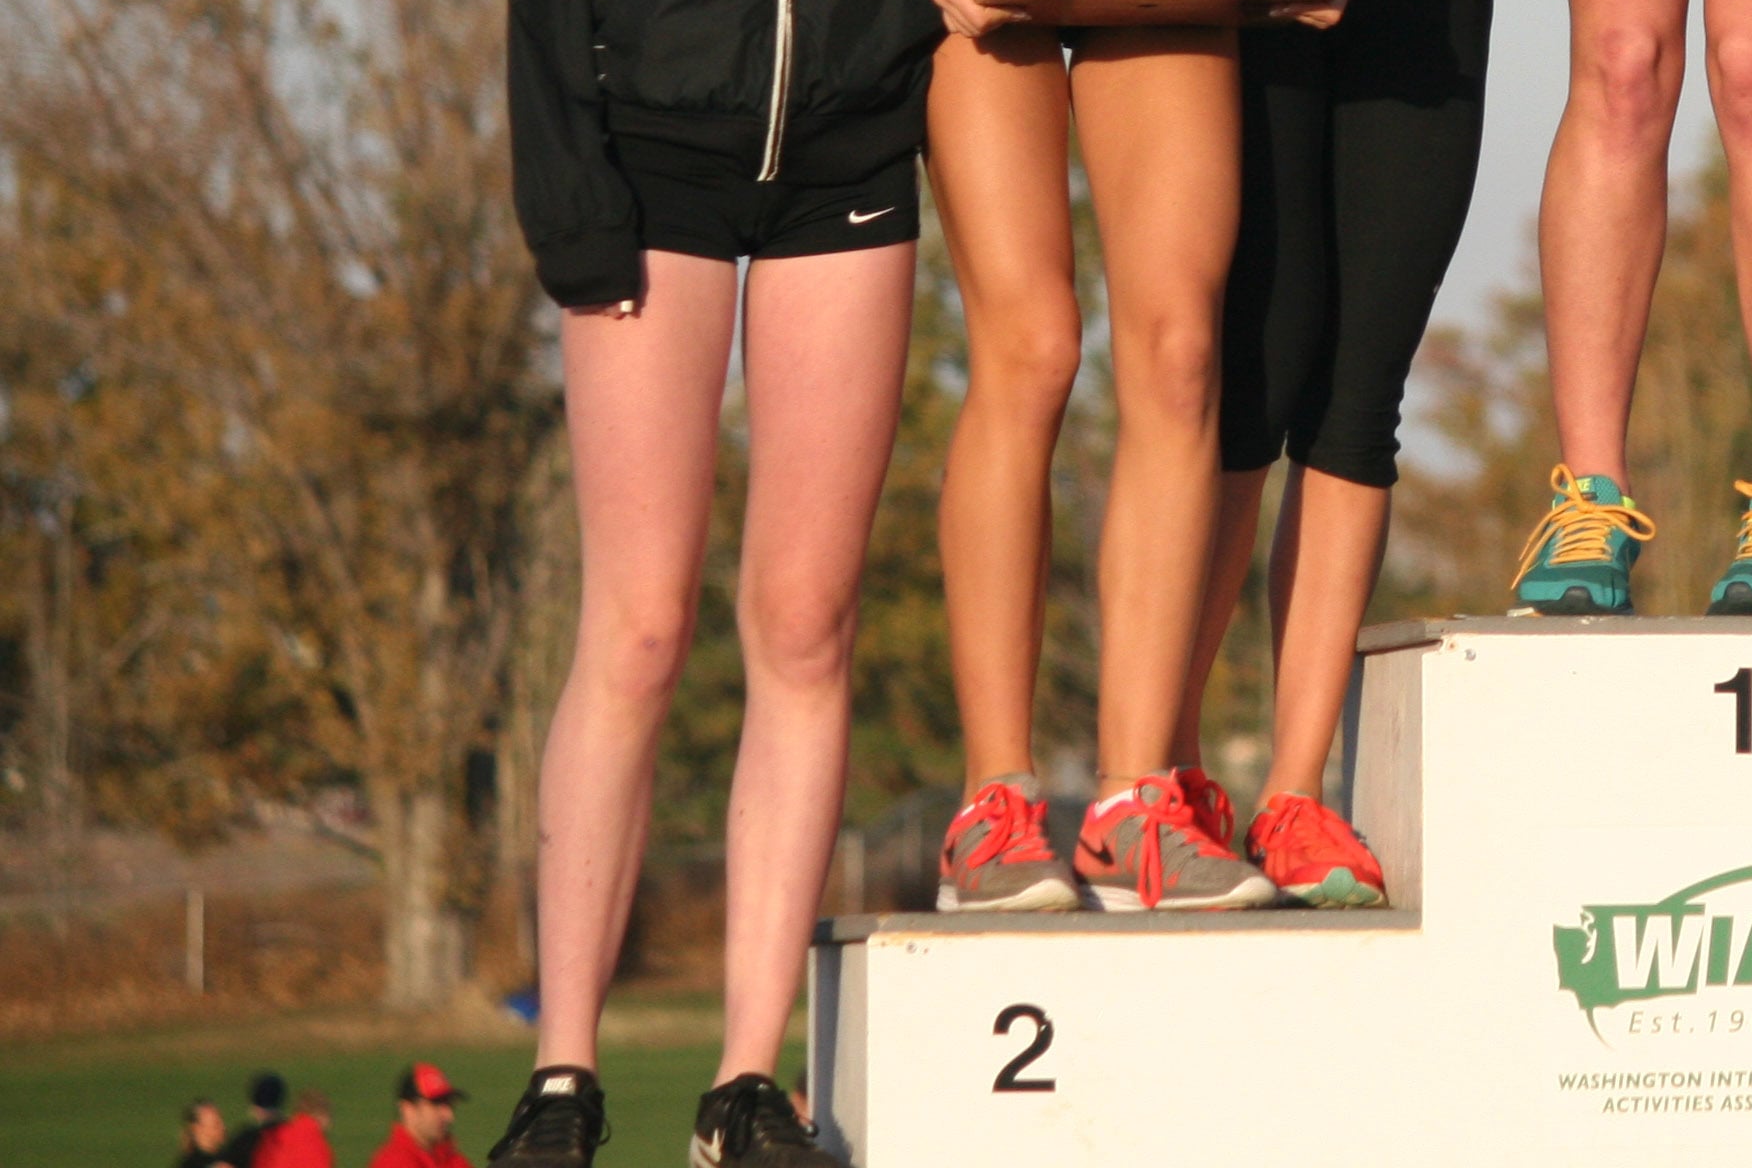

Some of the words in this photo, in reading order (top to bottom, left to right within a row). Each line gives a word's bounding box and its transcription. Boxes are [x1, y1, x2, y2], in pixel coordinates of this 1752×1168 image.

[992, 1003, 1056, 1093] 2
[543, 1077, 573, 1094] NIKE
[1558, 1071, 1702, 1091] WASHINGTON
[1602, 1095, 1714, 1113] ACTIVITIES
